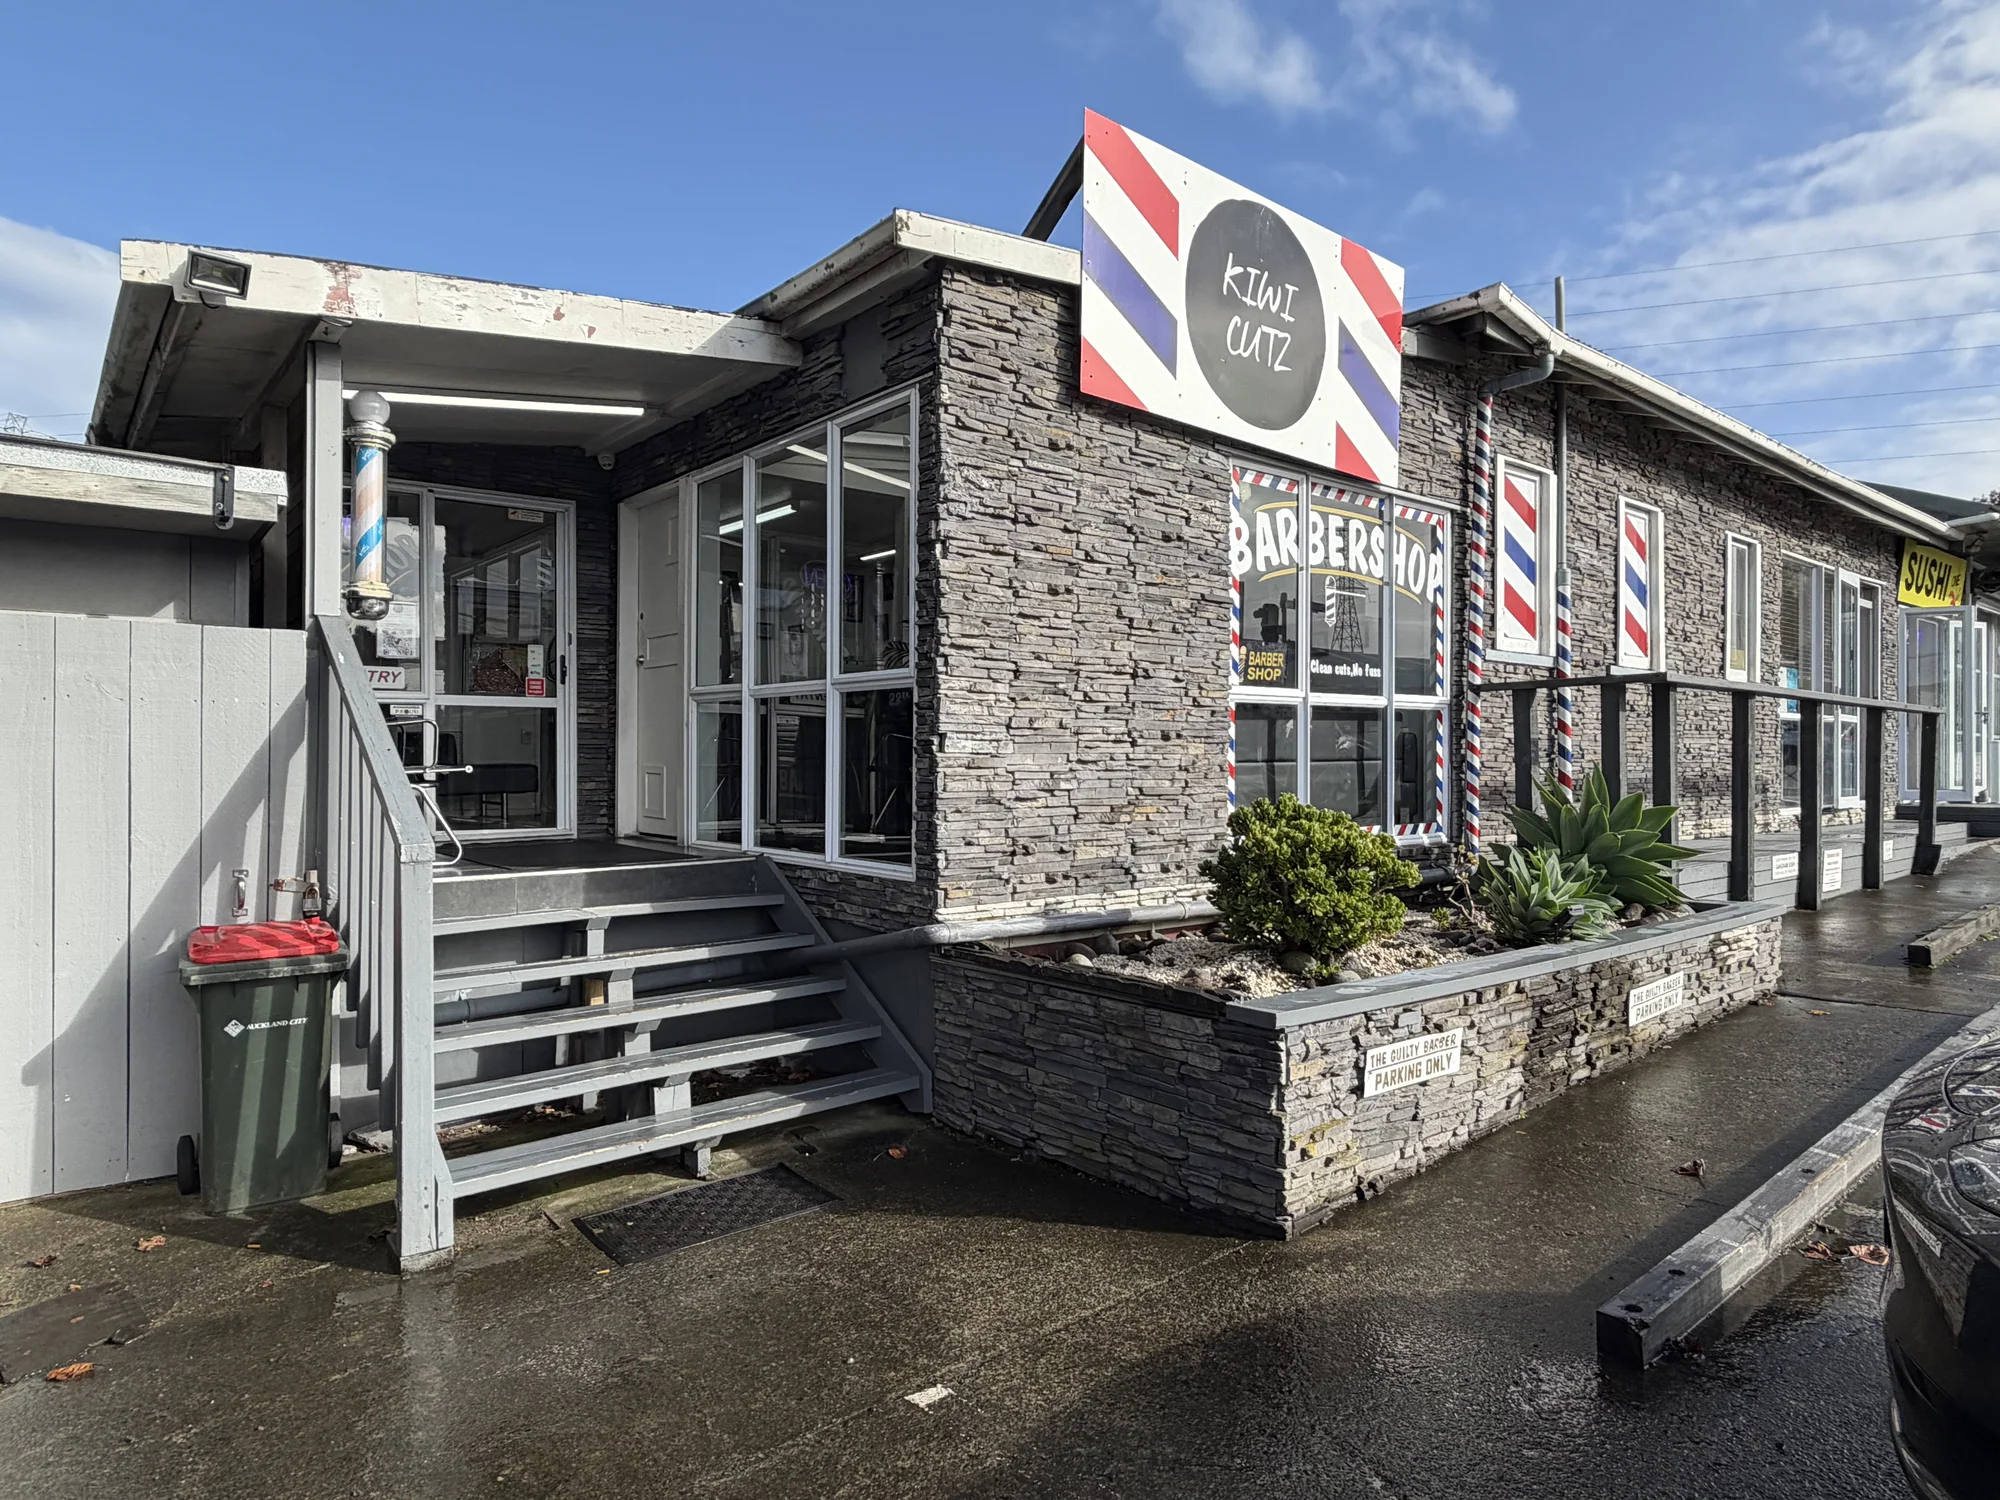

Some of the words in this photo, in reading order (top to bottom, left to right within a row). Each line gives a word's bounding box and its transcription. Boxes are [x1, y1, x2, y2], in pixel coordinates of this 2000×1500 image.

[1223, 252, 1299, 322] KIWI
[1226, 315, 1292, 372] CUTZ
[1904, 552, 1952, 601] SUSHI
[1248, 651, 1284, 667] BARBER
[1310, 659, 1333, 675] Clean
[1365, 663, 1382, 678] fuss
[367, 669, 402, 684] TRY
[1247, 666, 1282, 681] SHOP
[246, 1019, 288, 1030] AUCKLAND
[289, 1017, 309, 1026] CITY
[1370, 1051, 1387, 1069] THE
[1391, 1041, 1420, 1062] GUILTY
[1424, 1033, 1457, 1053] BARBER
[1375, 1061, 1422, 1091] PARKING
[1426, 1052, 1453, 1075] ONLY
